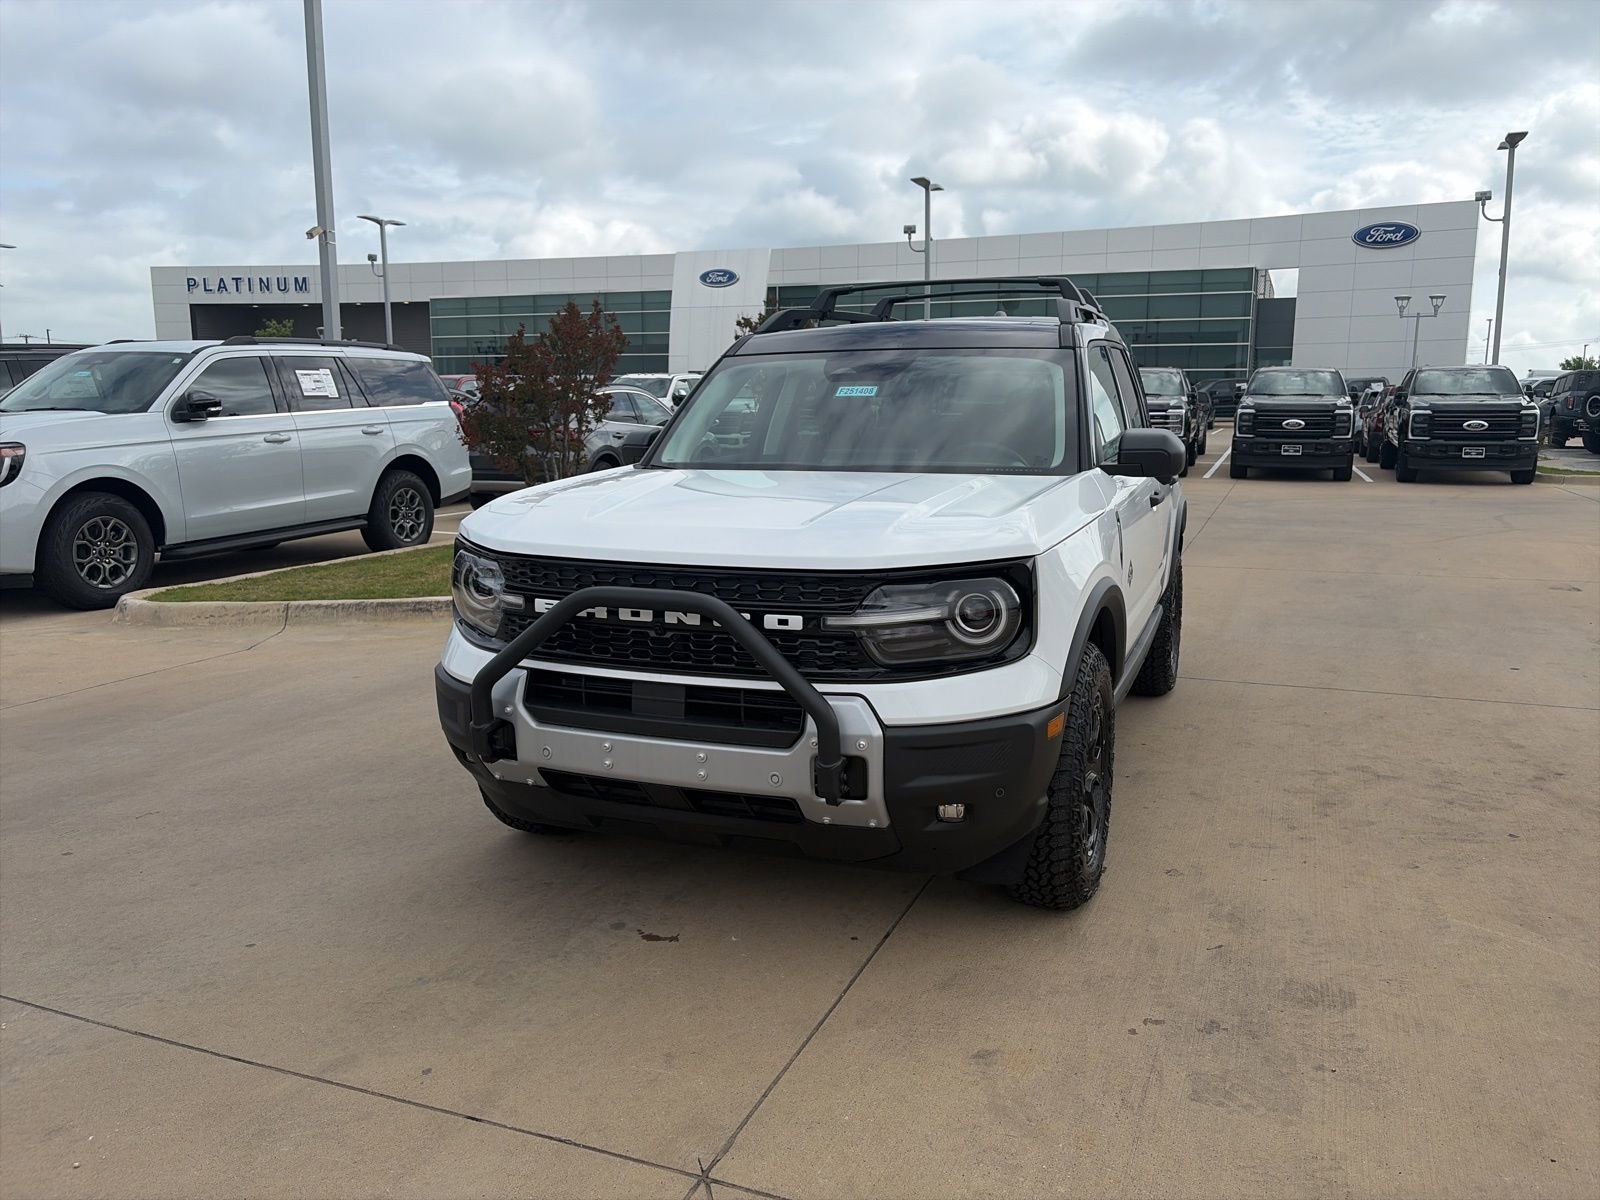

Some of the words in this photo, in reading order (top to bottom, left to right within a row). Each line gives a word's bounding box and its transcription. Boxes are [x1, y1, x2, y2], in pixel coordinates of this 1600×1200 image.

[1366, 226, 1405, 242] Ford
[186, 276, 309, 293] PLATINUM
[706, 271, 729, 282] Ford
[838, 387, 874, 395] F251408
[534, 598, 803, 631] BONO
